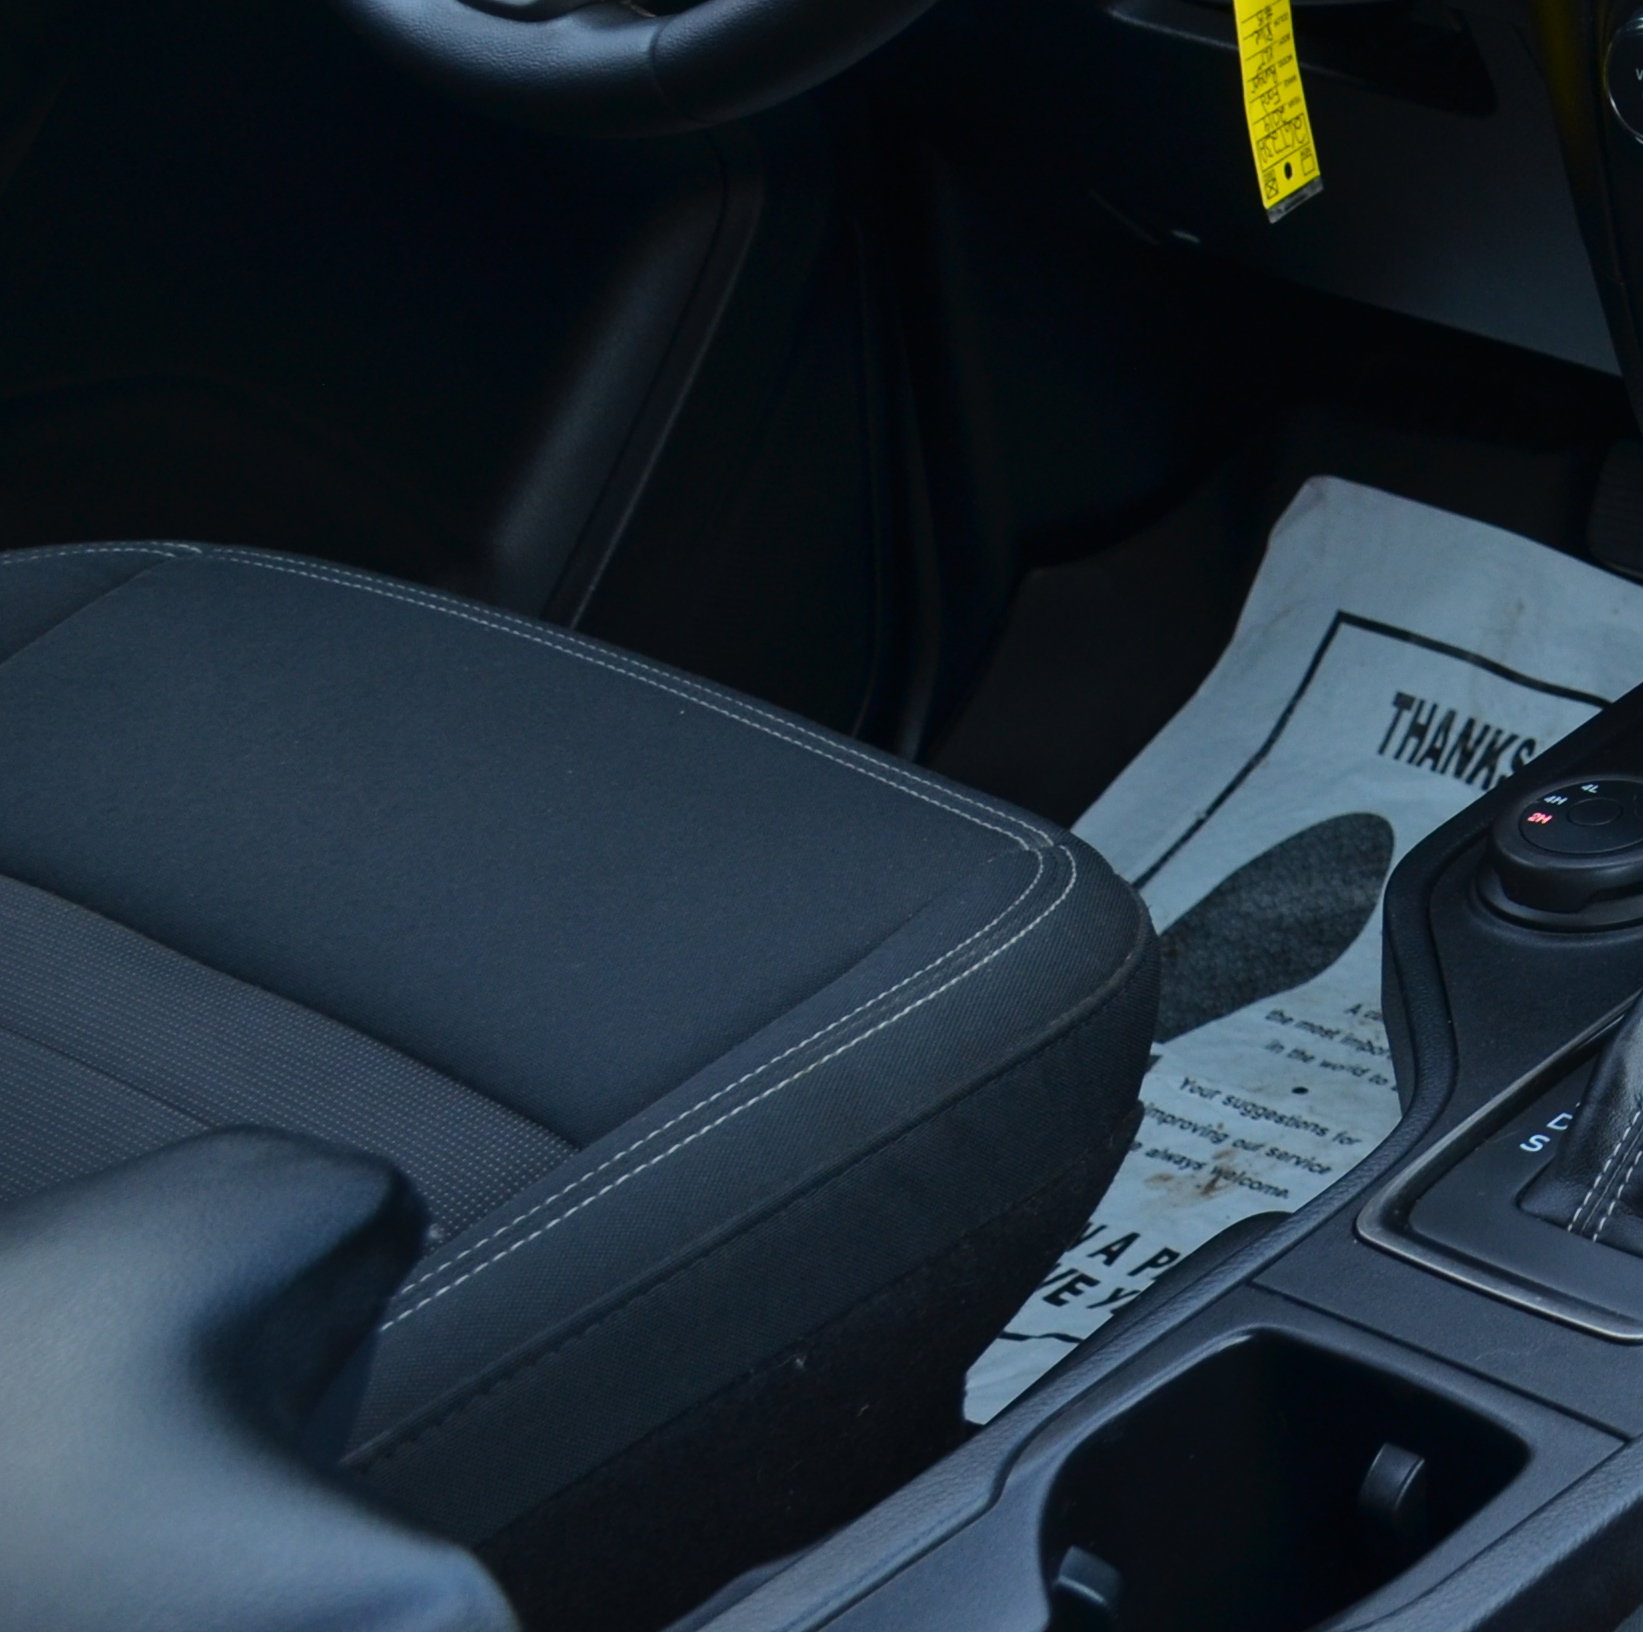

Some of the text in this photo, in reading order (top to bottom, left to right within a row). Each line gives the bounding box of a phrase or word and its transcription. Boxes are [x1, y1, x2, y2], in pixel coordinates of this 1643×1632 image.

[1377, 691, 1537, 792] THANKS
[1543, 795, 1568, 806] 4H
[1581, 783, 1599, 794] 4L
[1527, 811, 1554, 825] 2H
[1265, 1008, 1294, 1026] the
[1294, 1019, 1341, 1040] most
[1286, 1048, 1315, 1064] the
[1319, 1059, 1371, 1078] world
[1180, 1076, 1361, 1147] Your suggestions for
[1231, 1137, 1266, 1152] our
[1266, 1146, 1332, 1175] service
[1520, 1134, 1552, 1153] S
[1145, 1148, 1208, 1171] always
[1086, 1232, 1142, 1267] A
